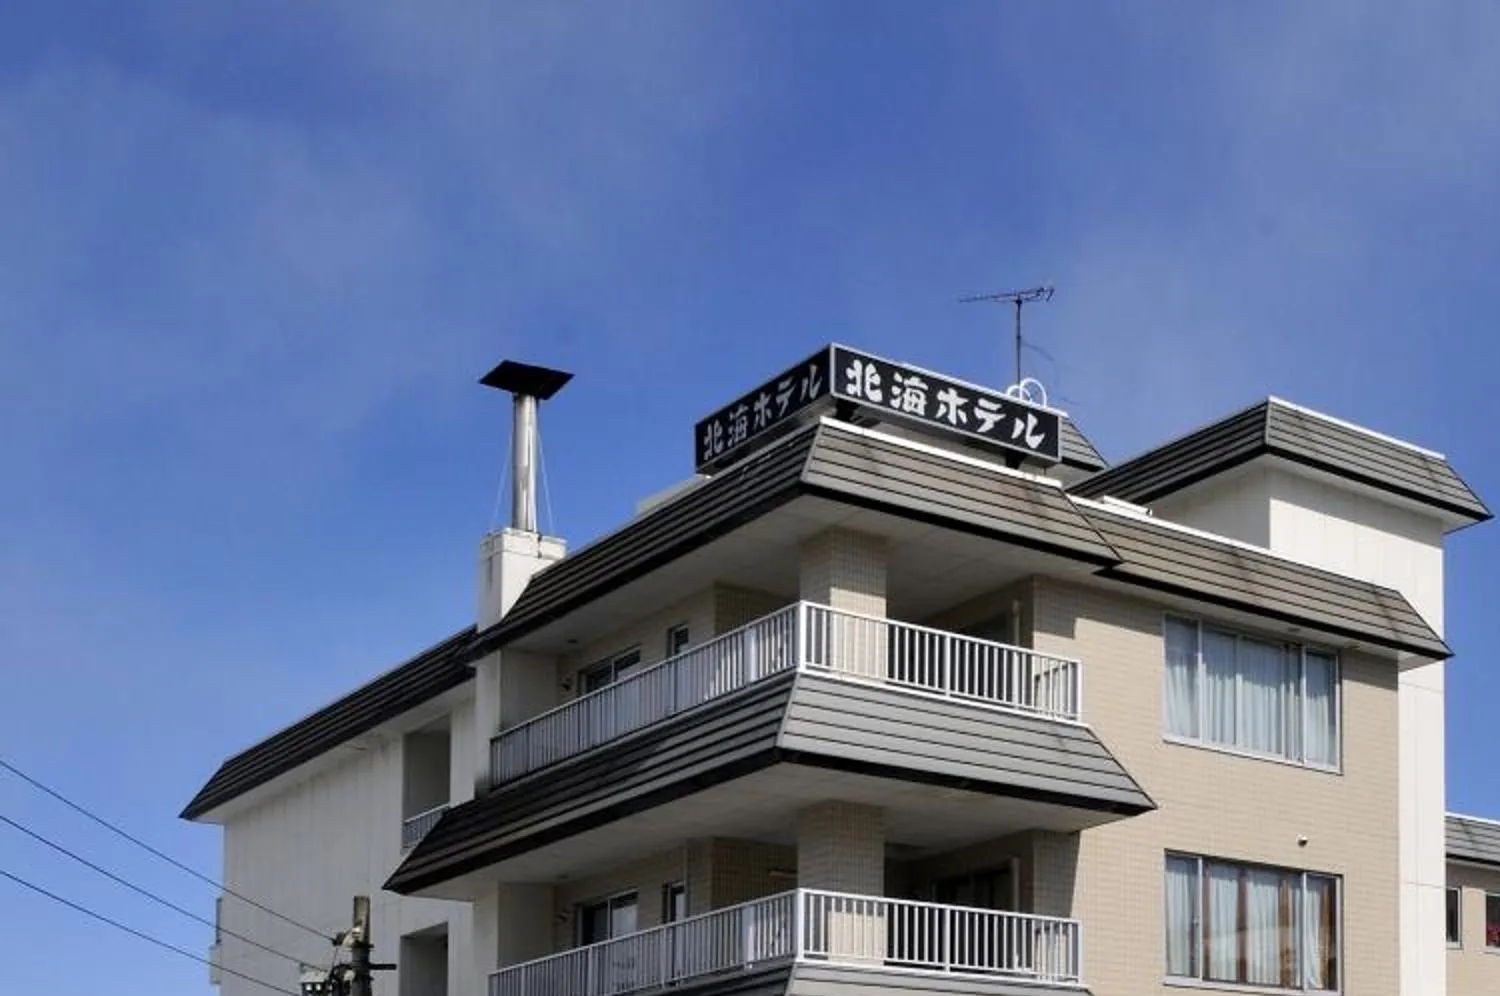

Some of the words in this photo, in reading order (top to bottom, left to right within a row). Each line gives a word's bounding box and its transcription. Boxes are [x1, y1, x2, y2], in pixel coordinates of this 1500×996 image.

[704, 364, 824, 460] 北海ホテル
[846, 359, 1045, 450] 北海ホテル
